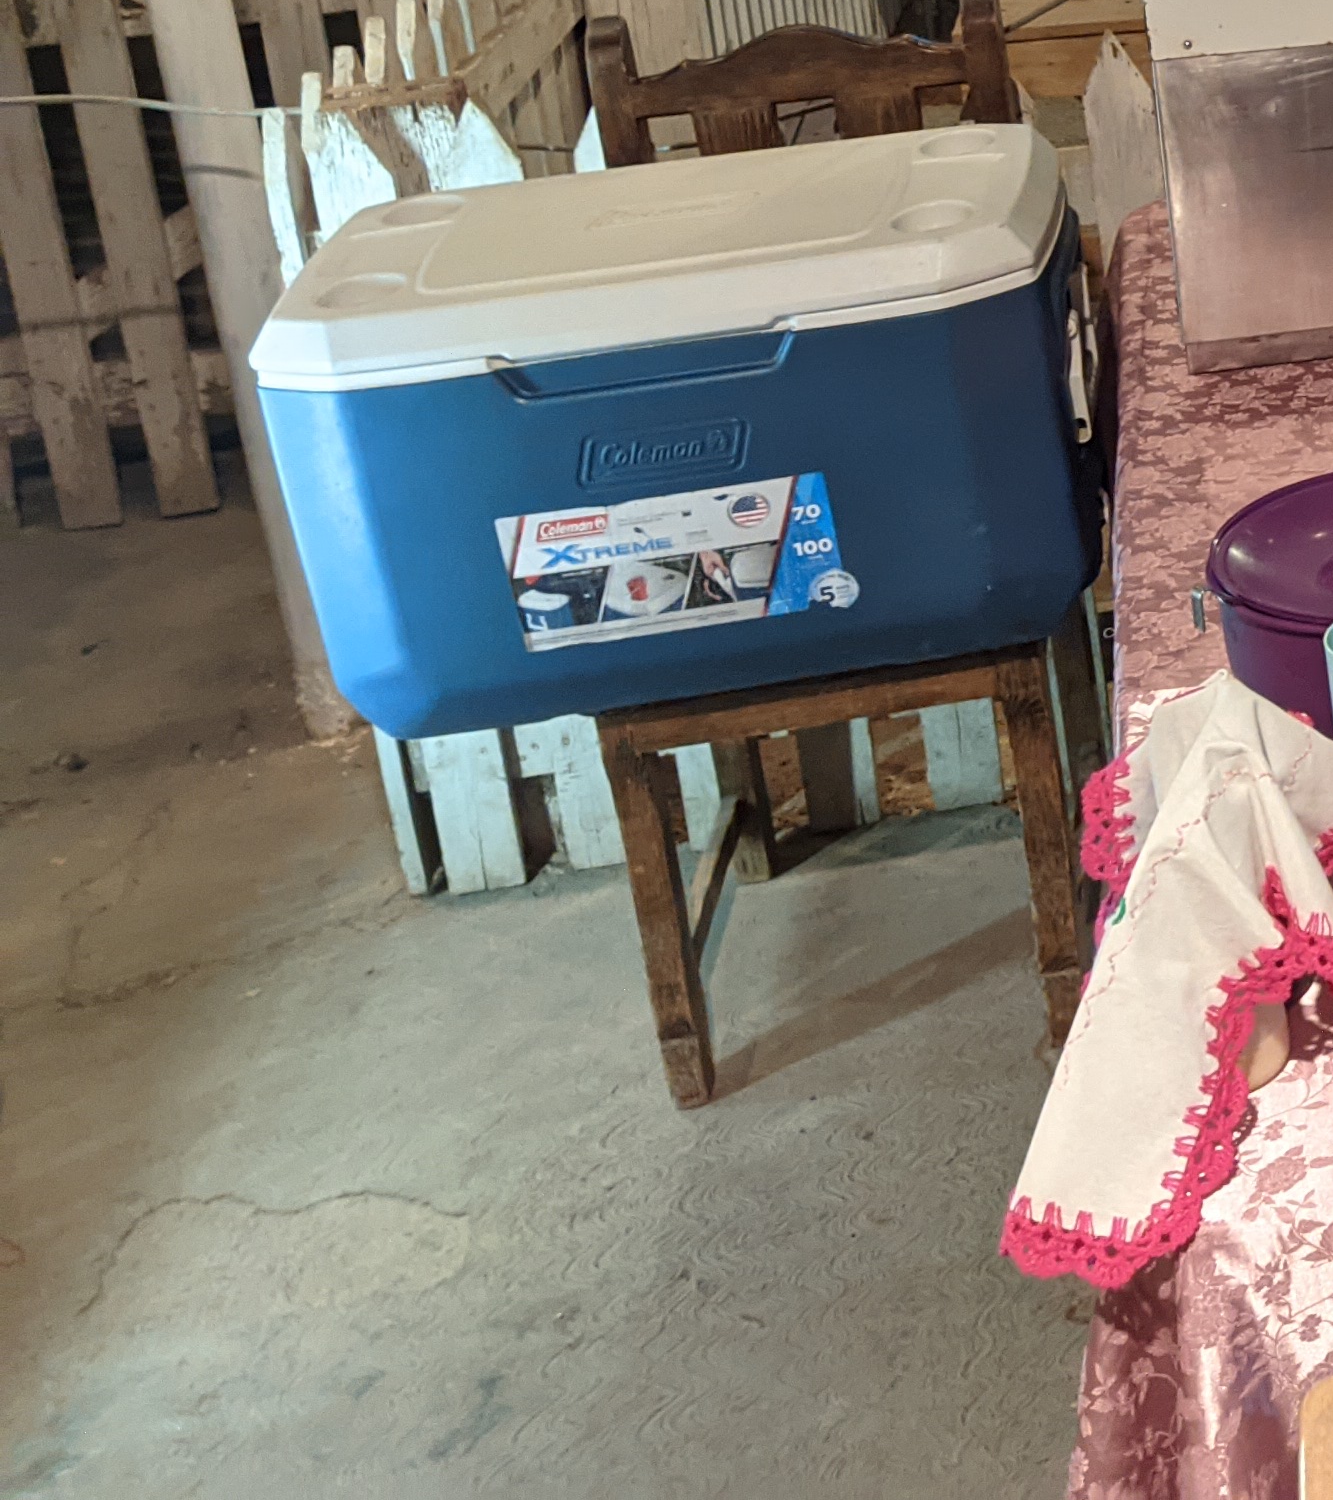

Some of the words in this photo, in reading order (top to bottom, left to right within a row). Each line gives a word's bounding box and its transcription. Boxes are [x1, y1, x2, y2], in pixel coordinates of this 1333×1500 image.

[600, 440, 703, 469] Coleman
[791, 504, 822, 521] 70
[540, 519, 593, 538] Coleman
[538, 537, 673, 569] XTREME
[792, 537, 833, 556] 100
